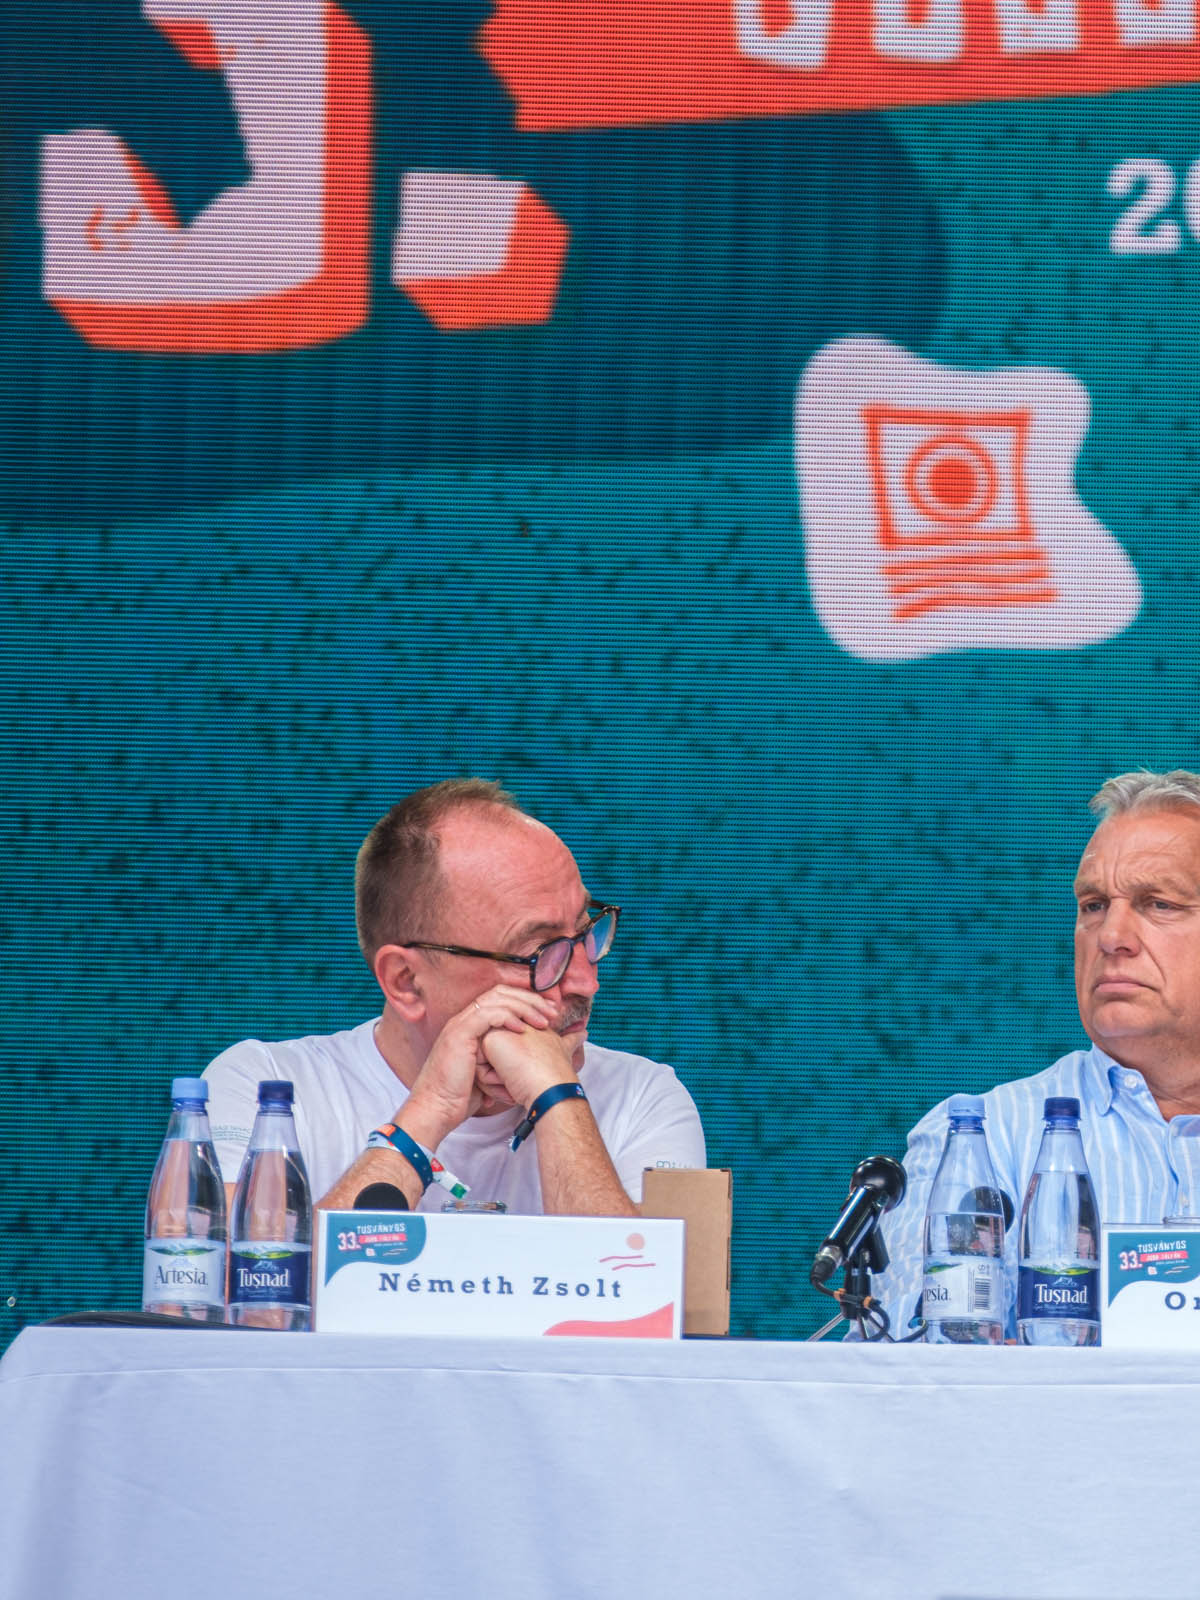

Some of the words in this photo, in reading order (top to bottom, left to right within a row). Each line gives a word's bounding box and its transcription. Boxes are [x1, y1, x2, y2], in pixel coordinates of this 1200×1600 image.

[154, 1265, 207, 1286] Artesia
[378, 1272, 514, 1295] Németh
[532, 1276, 622, 1298] Zsolt
